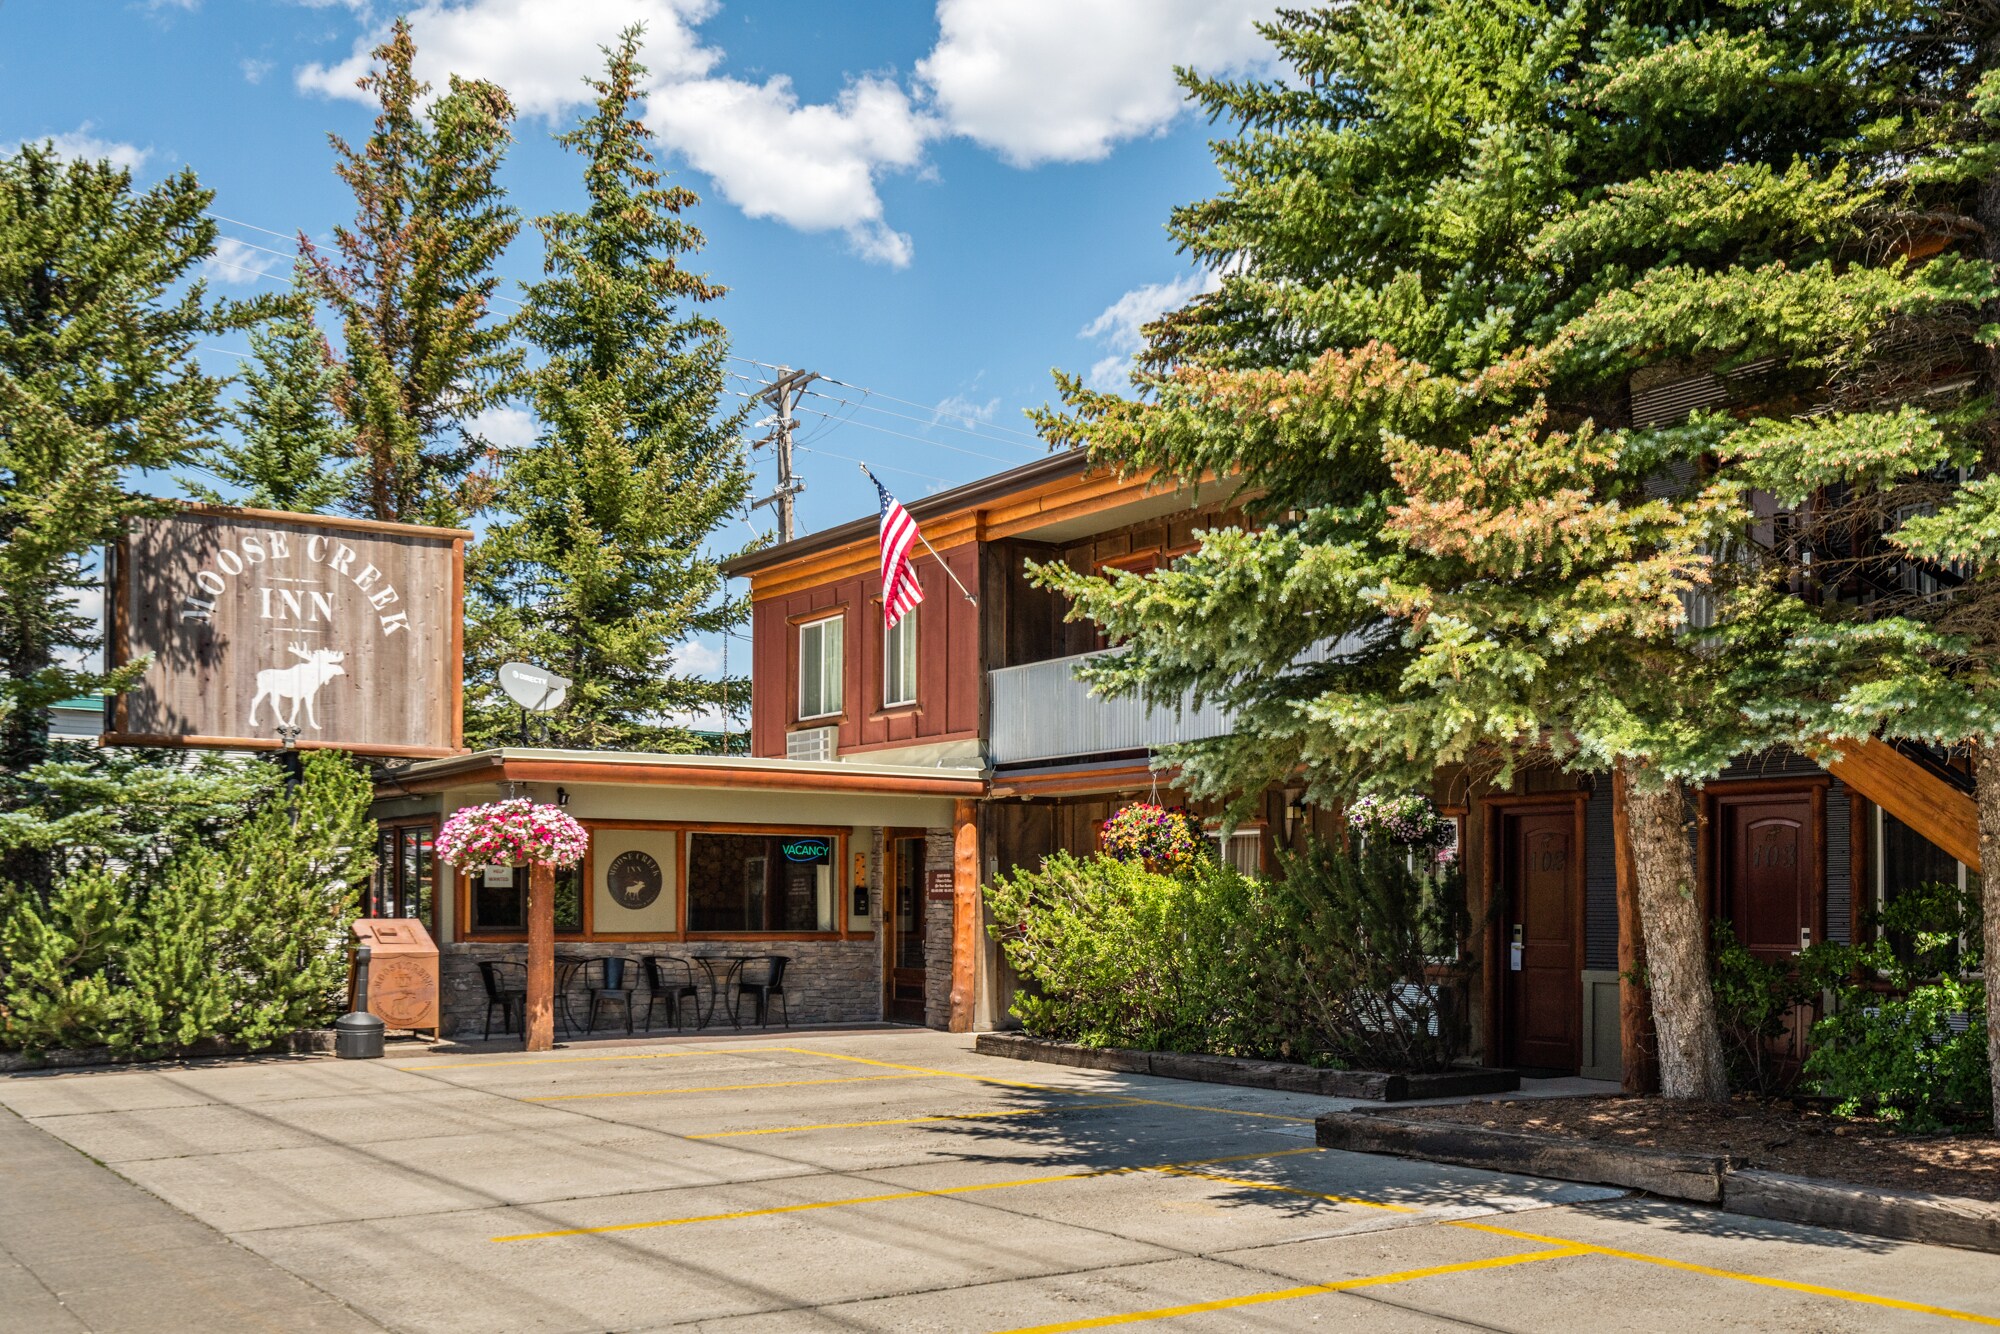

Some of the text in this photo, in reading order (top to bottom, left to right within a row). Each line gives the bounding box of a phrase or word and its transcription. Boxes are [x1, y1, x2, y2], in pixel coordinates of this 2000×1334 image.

[183, 531, 412, 637] MOOSE CREEK
[259, 587, 334, 623] INN
[609, 853, 660, 877] MOOSE CREEK
[782, 844, 829, 856] VACANCY
